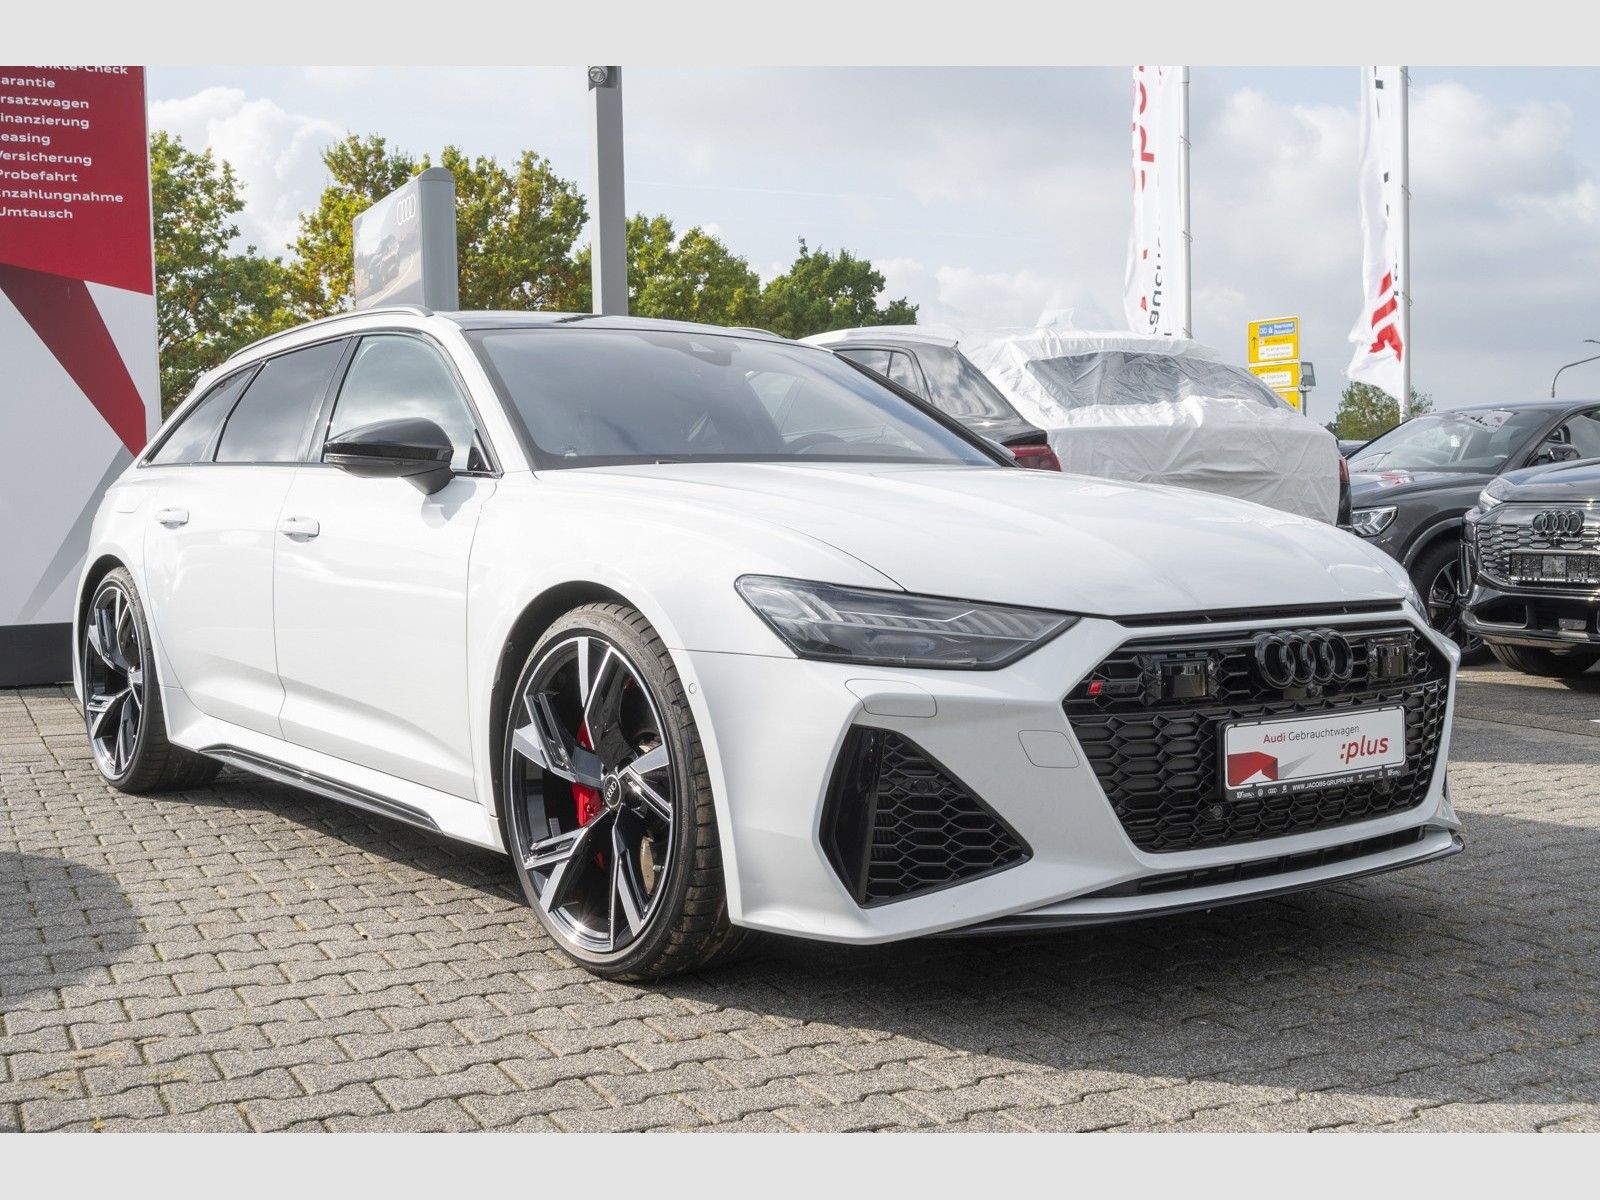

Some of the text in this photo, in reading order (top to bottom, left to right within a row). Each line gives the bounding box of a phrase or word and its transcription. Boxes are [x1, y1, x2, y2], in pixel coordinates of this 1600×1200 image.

[0, 77, 56, 88] arantie
[0, 95, 90, 110] rsatzwagen
[0, 113, 90, 129] inanzierung
[0, 133, 51, 146] easing
[0, 188, 124, 203] nzahlungnahme
[1263, 725, 1360, 744] Audi Gebrauchtwagen
[1340, 735, 1389, 764] :plus
